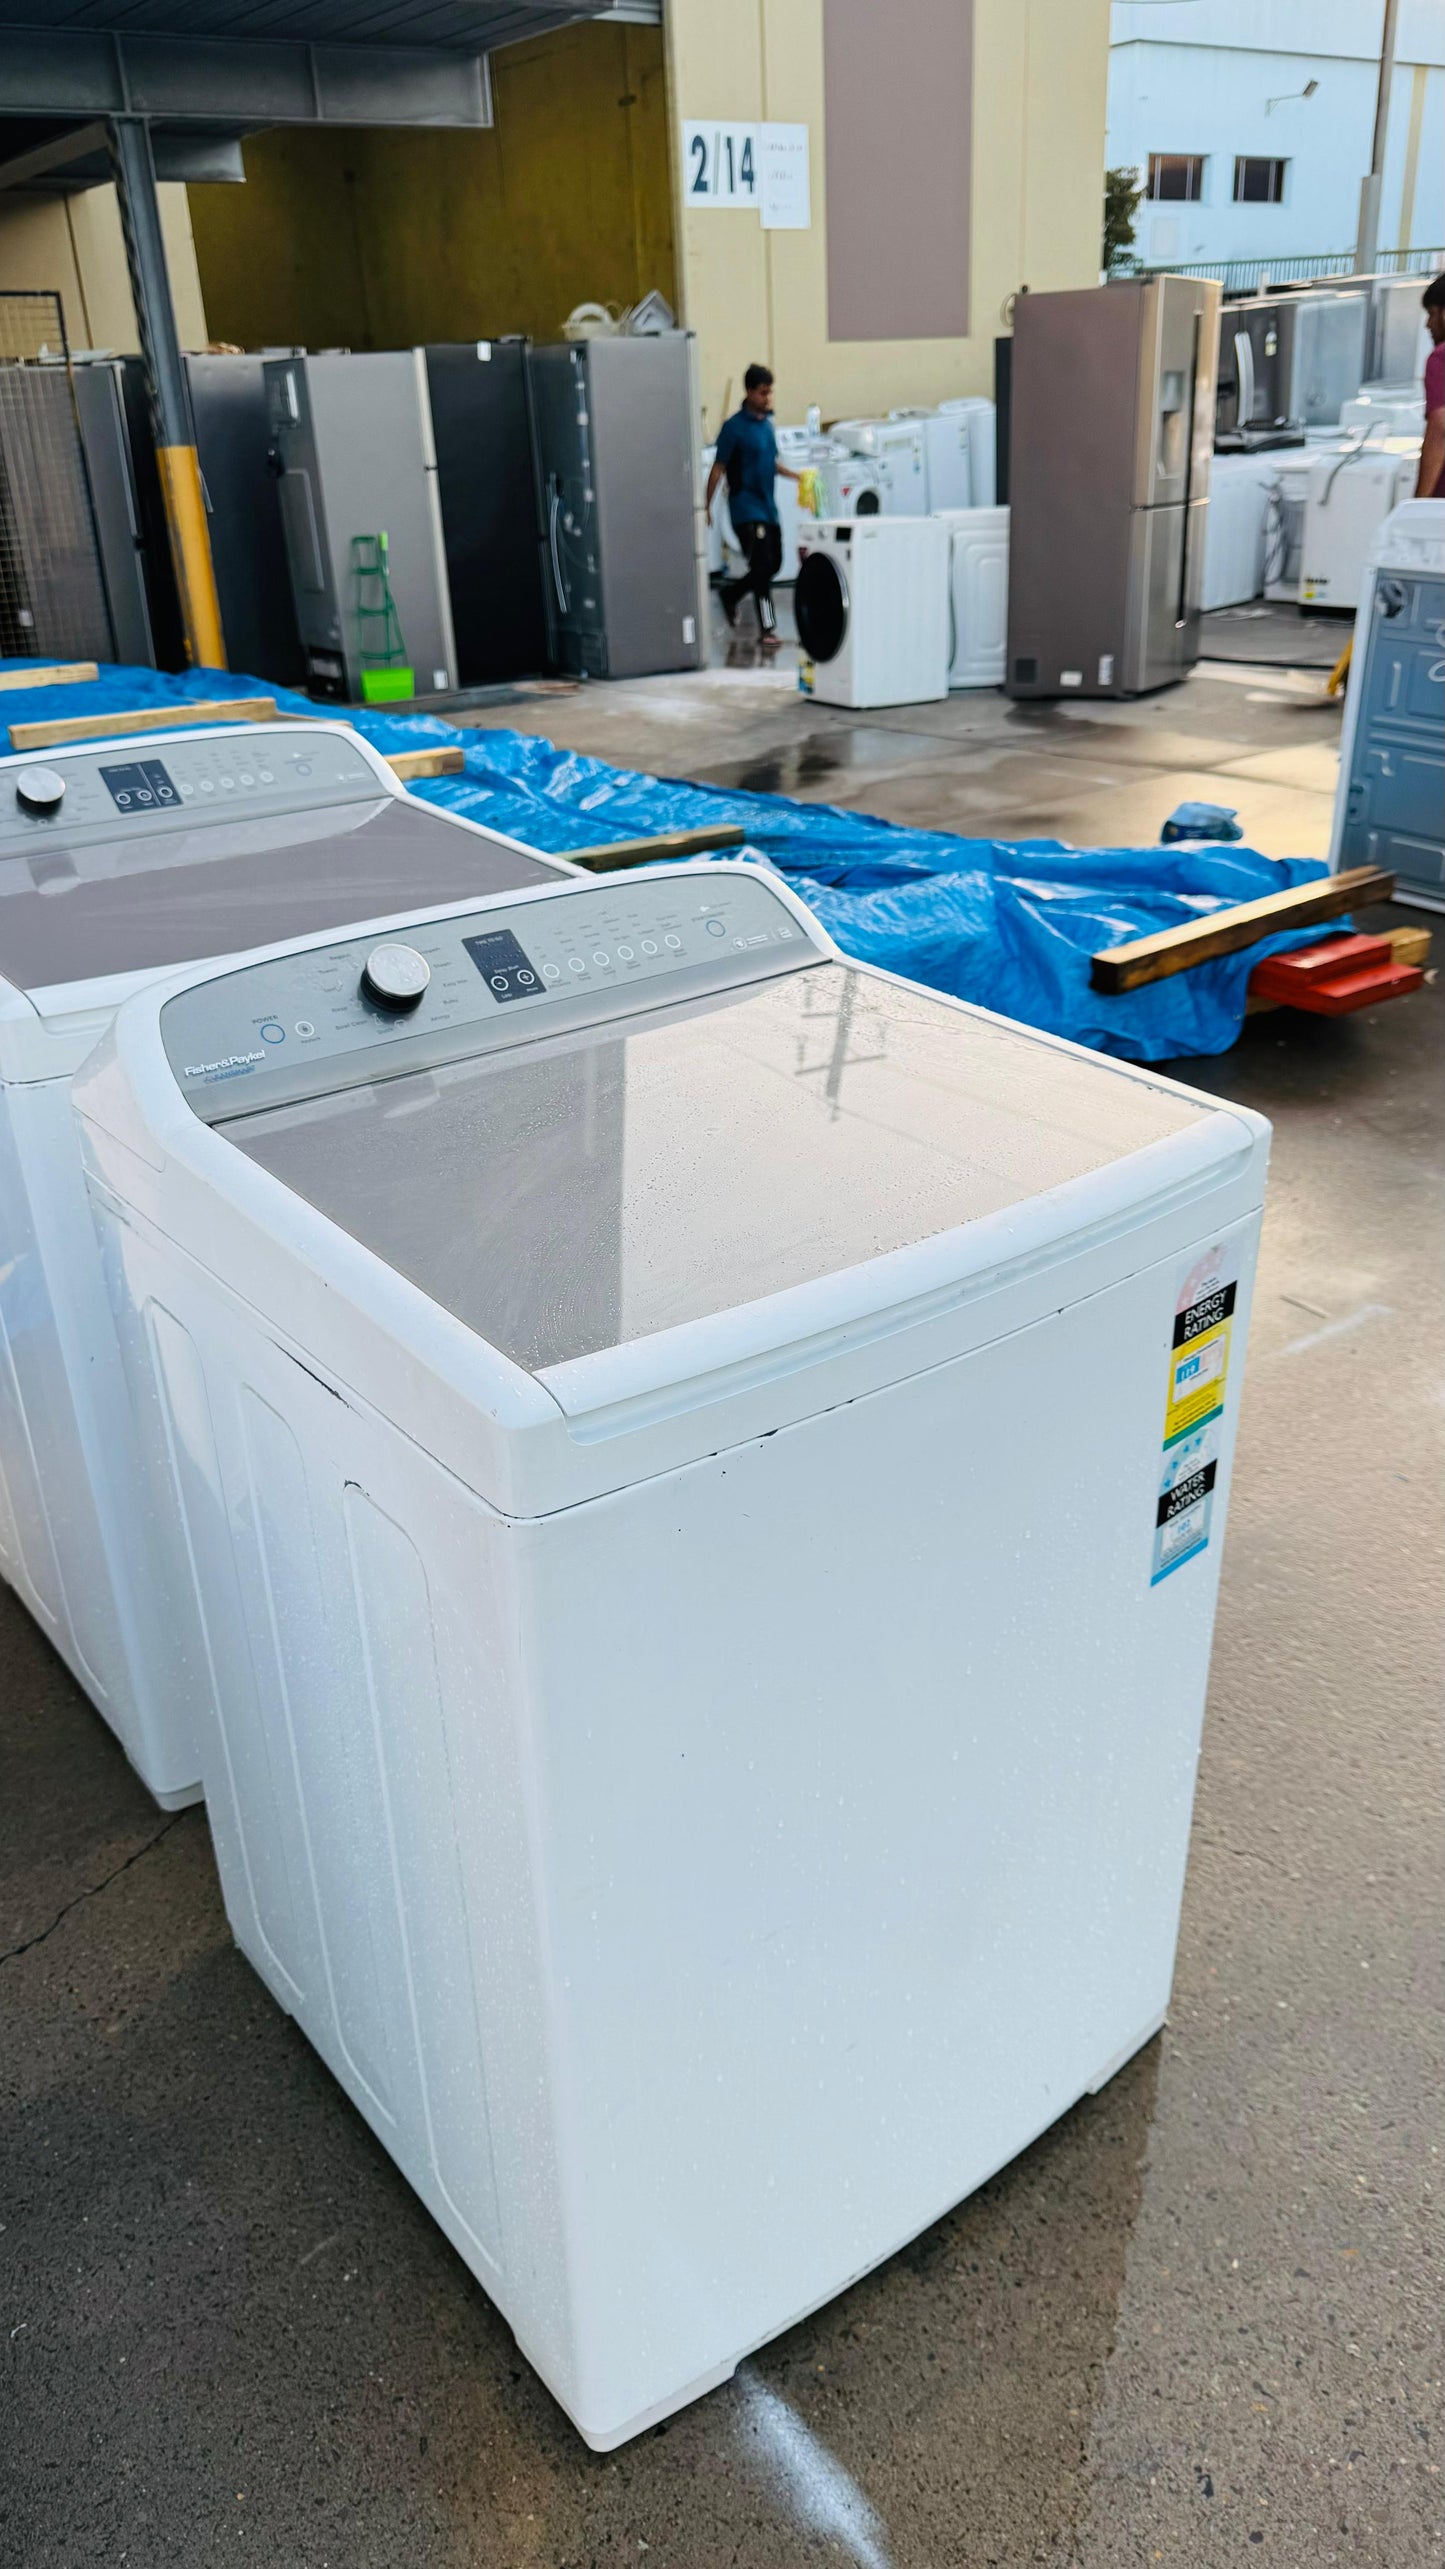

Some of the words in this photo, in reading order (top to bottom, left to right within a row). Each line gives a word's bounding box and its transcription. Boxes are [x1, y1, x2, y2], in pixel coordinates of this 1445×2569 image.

[252, 1015, 279, 1025] POWER
[184, 1049, 266, 1077] Fisher&Paykel
[1184, 1290, 1228, 1325] ENERGY
[1183, 1307, 1225, 1341] RATING
[1166, 1483, 1206, 1519] RATING
[1170, 1471, 1206, 1501] WATER
